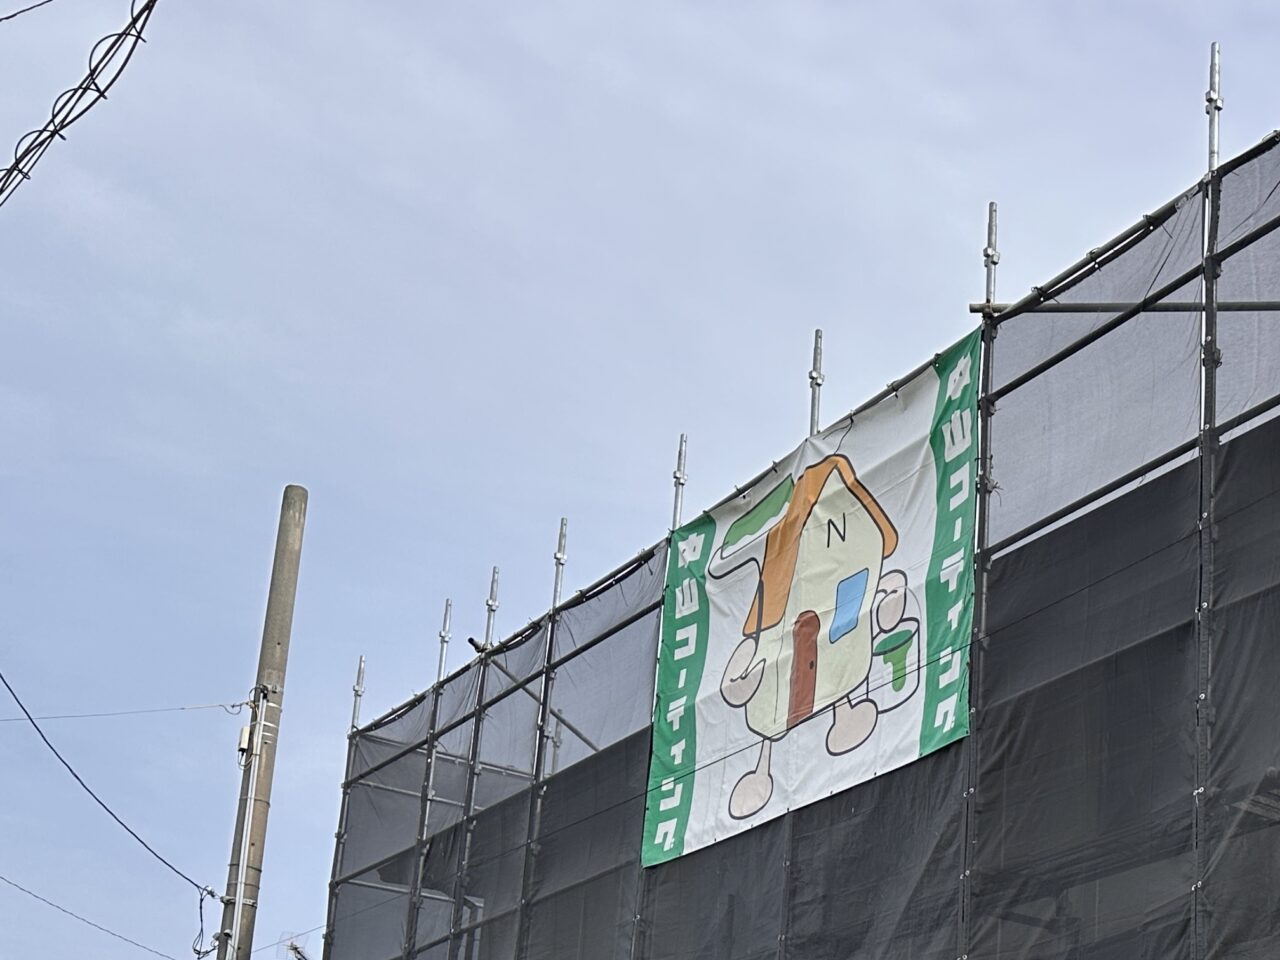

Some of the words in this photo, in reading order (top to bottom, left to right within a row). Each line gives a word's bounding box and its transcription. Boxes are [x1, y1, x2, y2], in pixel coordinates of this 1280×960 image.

[827, 511, 846, 549] N
[934, 351, 972, 734] 中山コーティング
[654, 531, 705, 852] 中山コーティング
